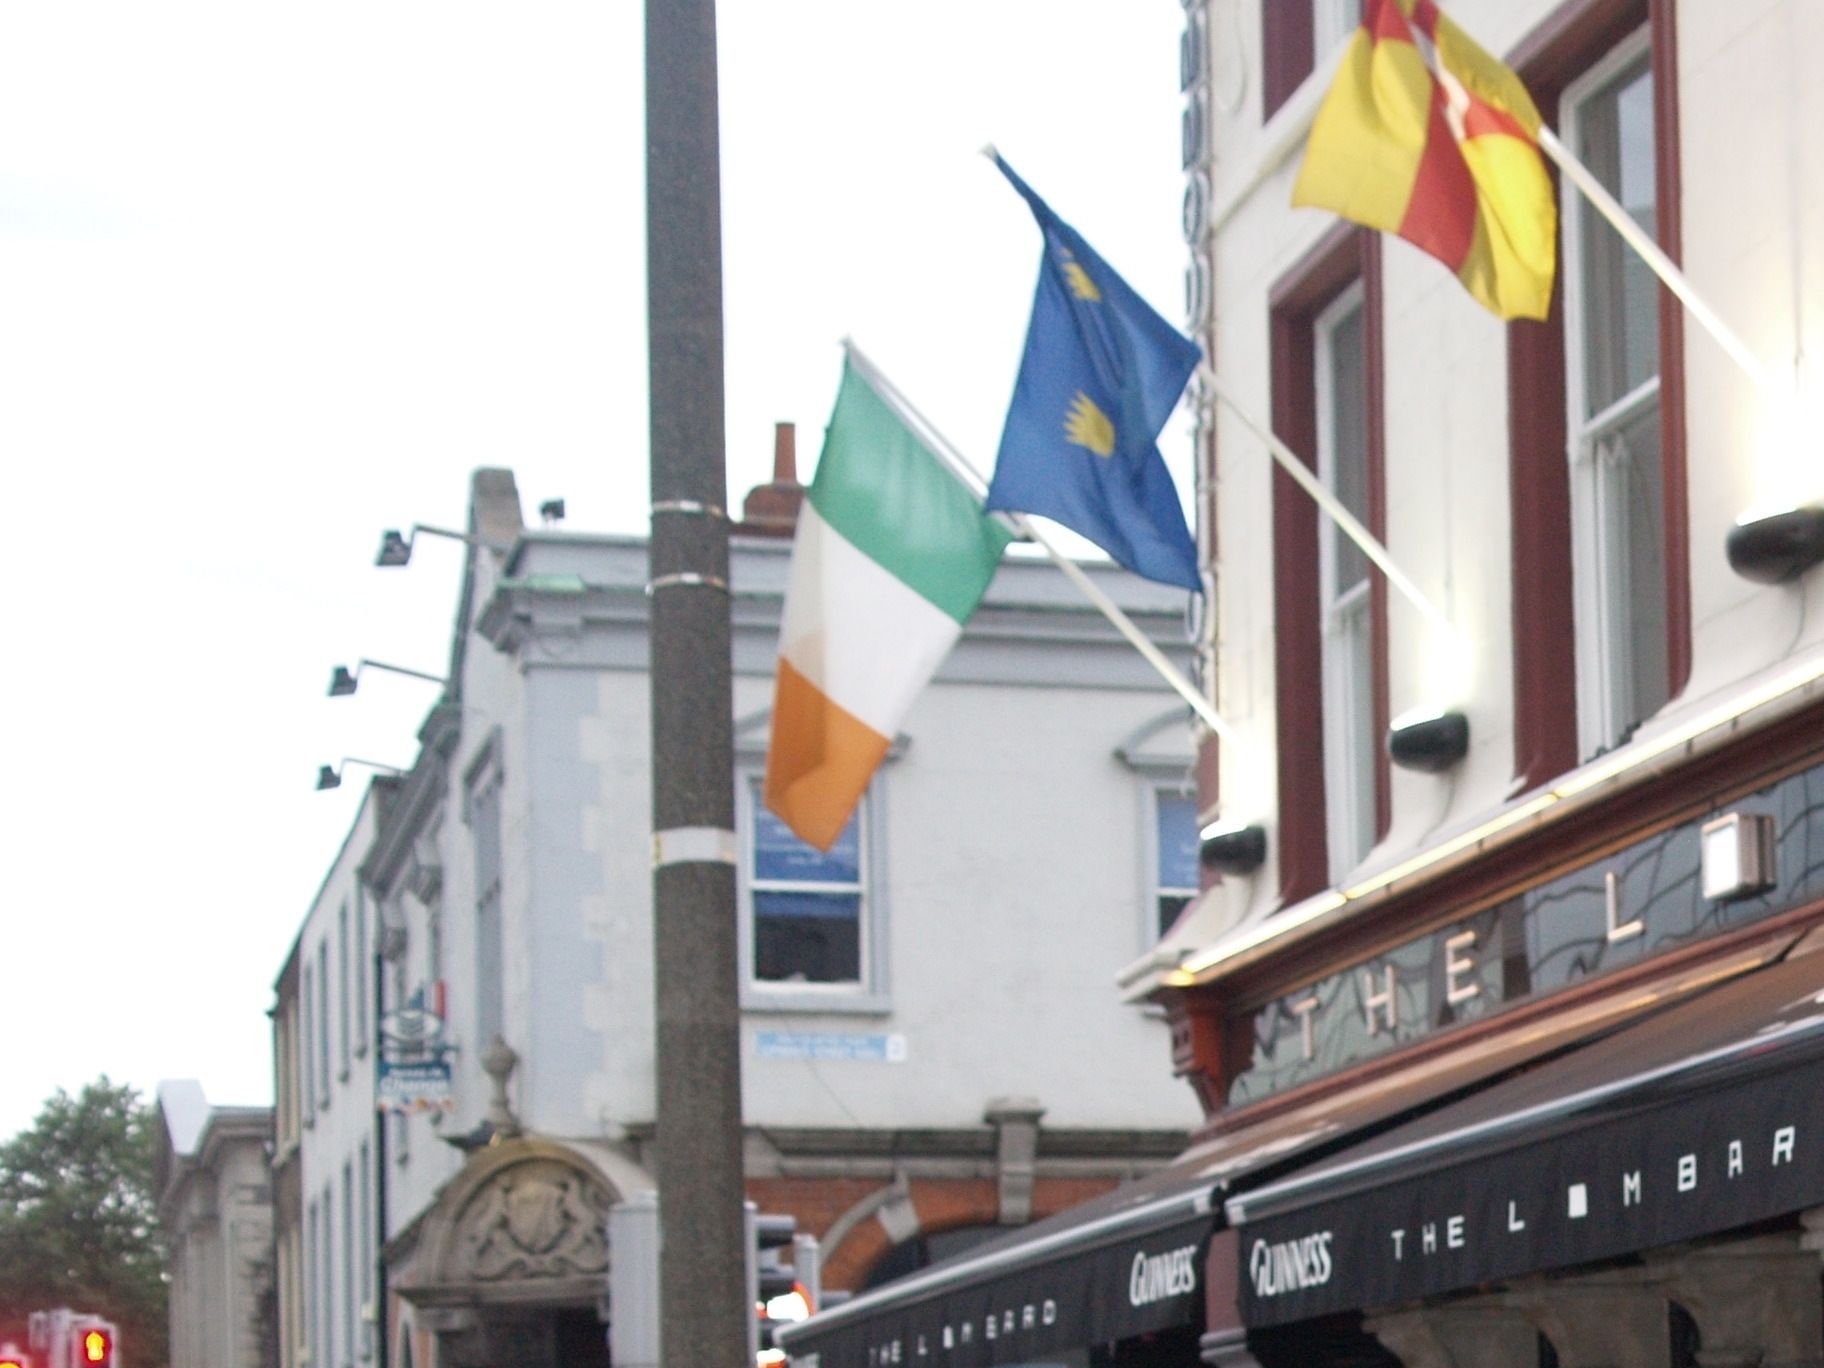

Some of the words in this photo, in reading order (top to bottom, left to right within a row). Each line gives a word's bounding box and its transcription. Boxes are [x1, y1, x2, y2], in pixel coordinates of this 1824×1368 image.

[1292, 929, 1480, 1060] THE
[868, 1337, 903, 1367] THE
[1129, 1245, 1199, 1308] GUINNESS
[1250, 1230, 1333, 1298] GUINNESS
[1390, 1215, 1465, 1261] THE
